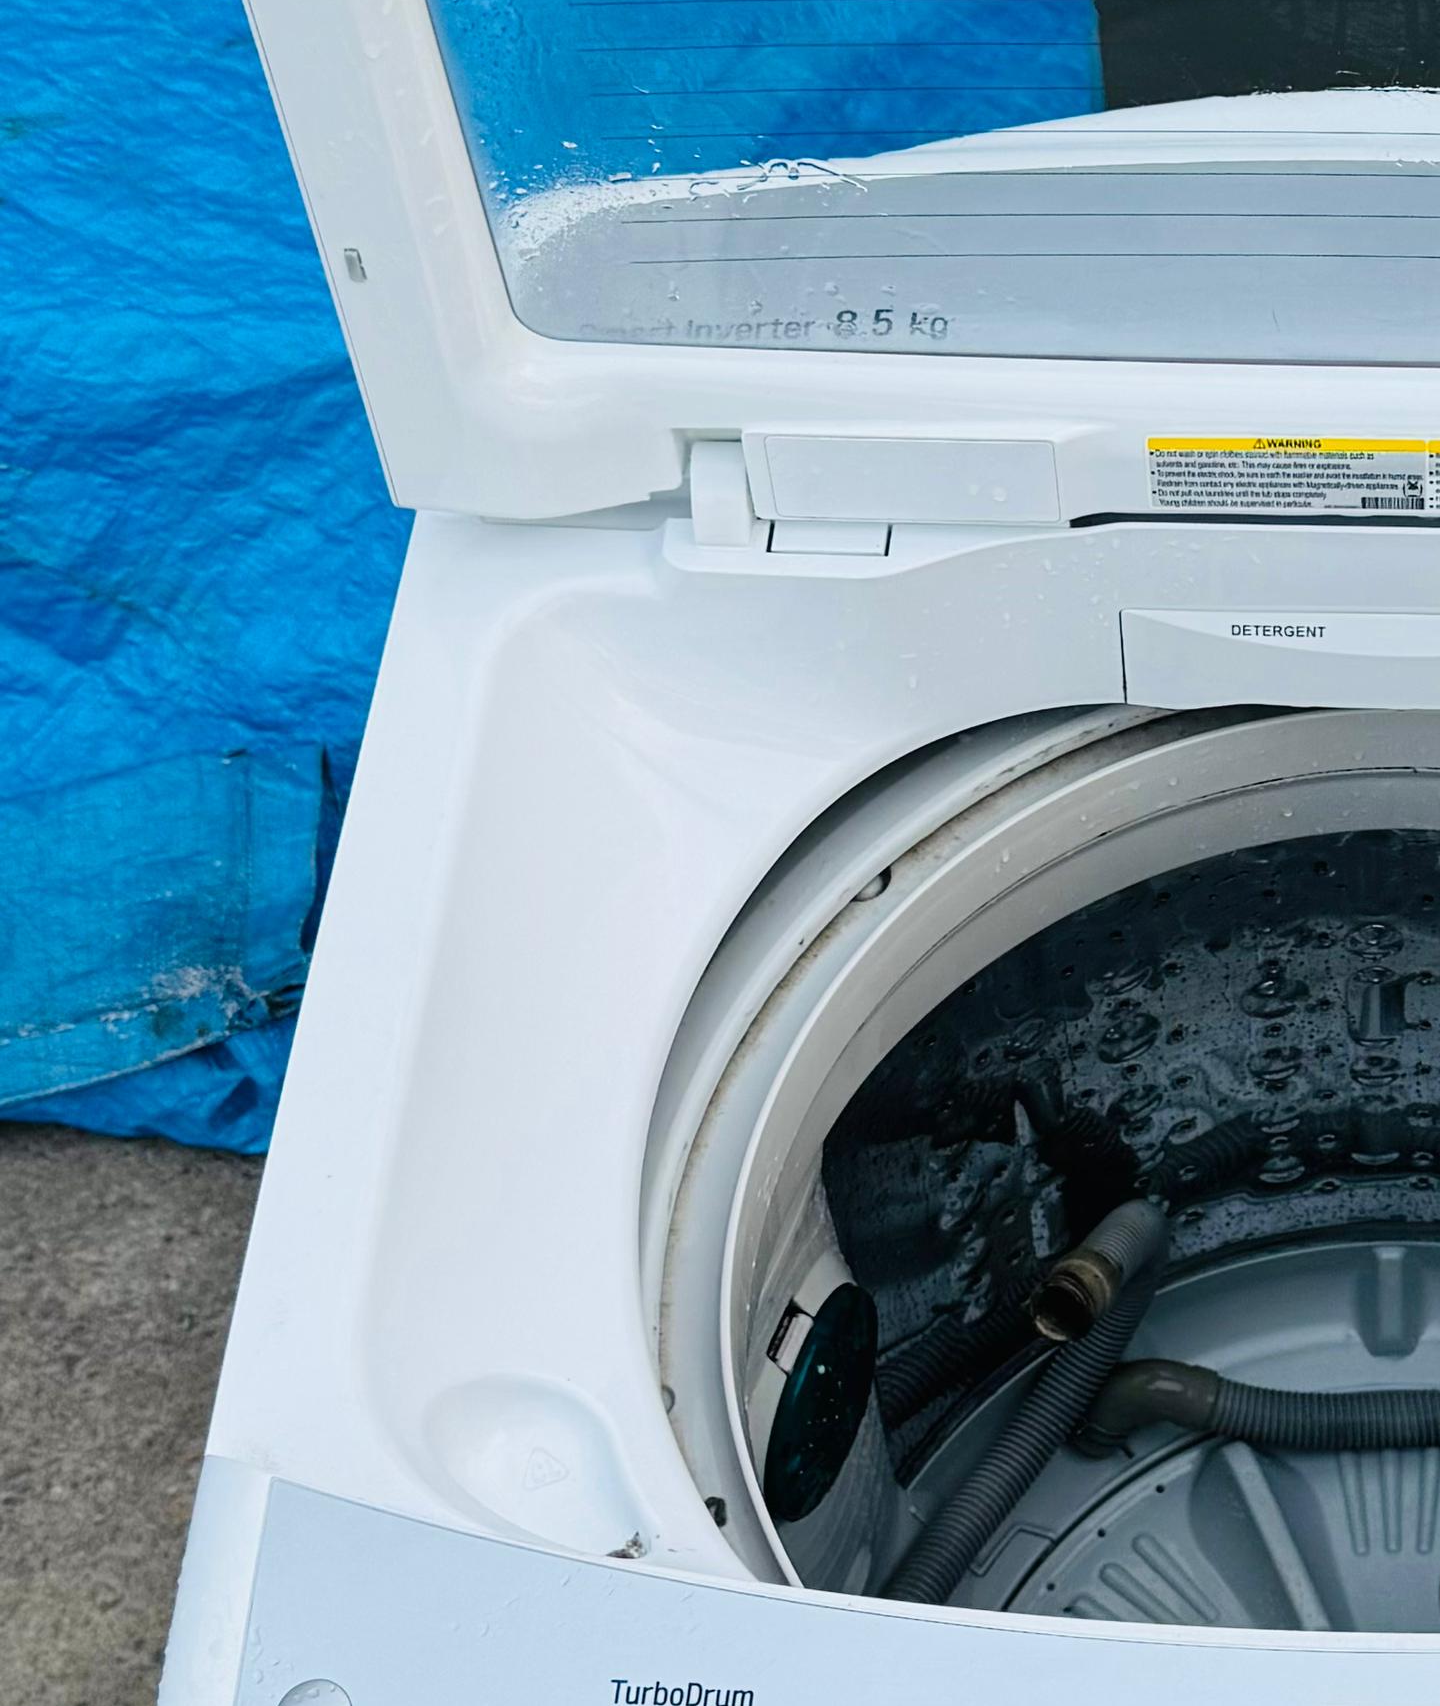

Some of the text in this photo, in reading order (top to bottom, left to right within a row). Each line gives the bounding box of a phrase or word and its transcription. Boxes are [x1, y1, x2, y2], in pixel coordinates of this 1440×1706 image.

[687, 318, 816, 341] Inverter
[909, 311, 951, 341] kg
[1267, 439, 1322, 449] WARNING
[1232, 625, 1326, 637] DETERGENT
